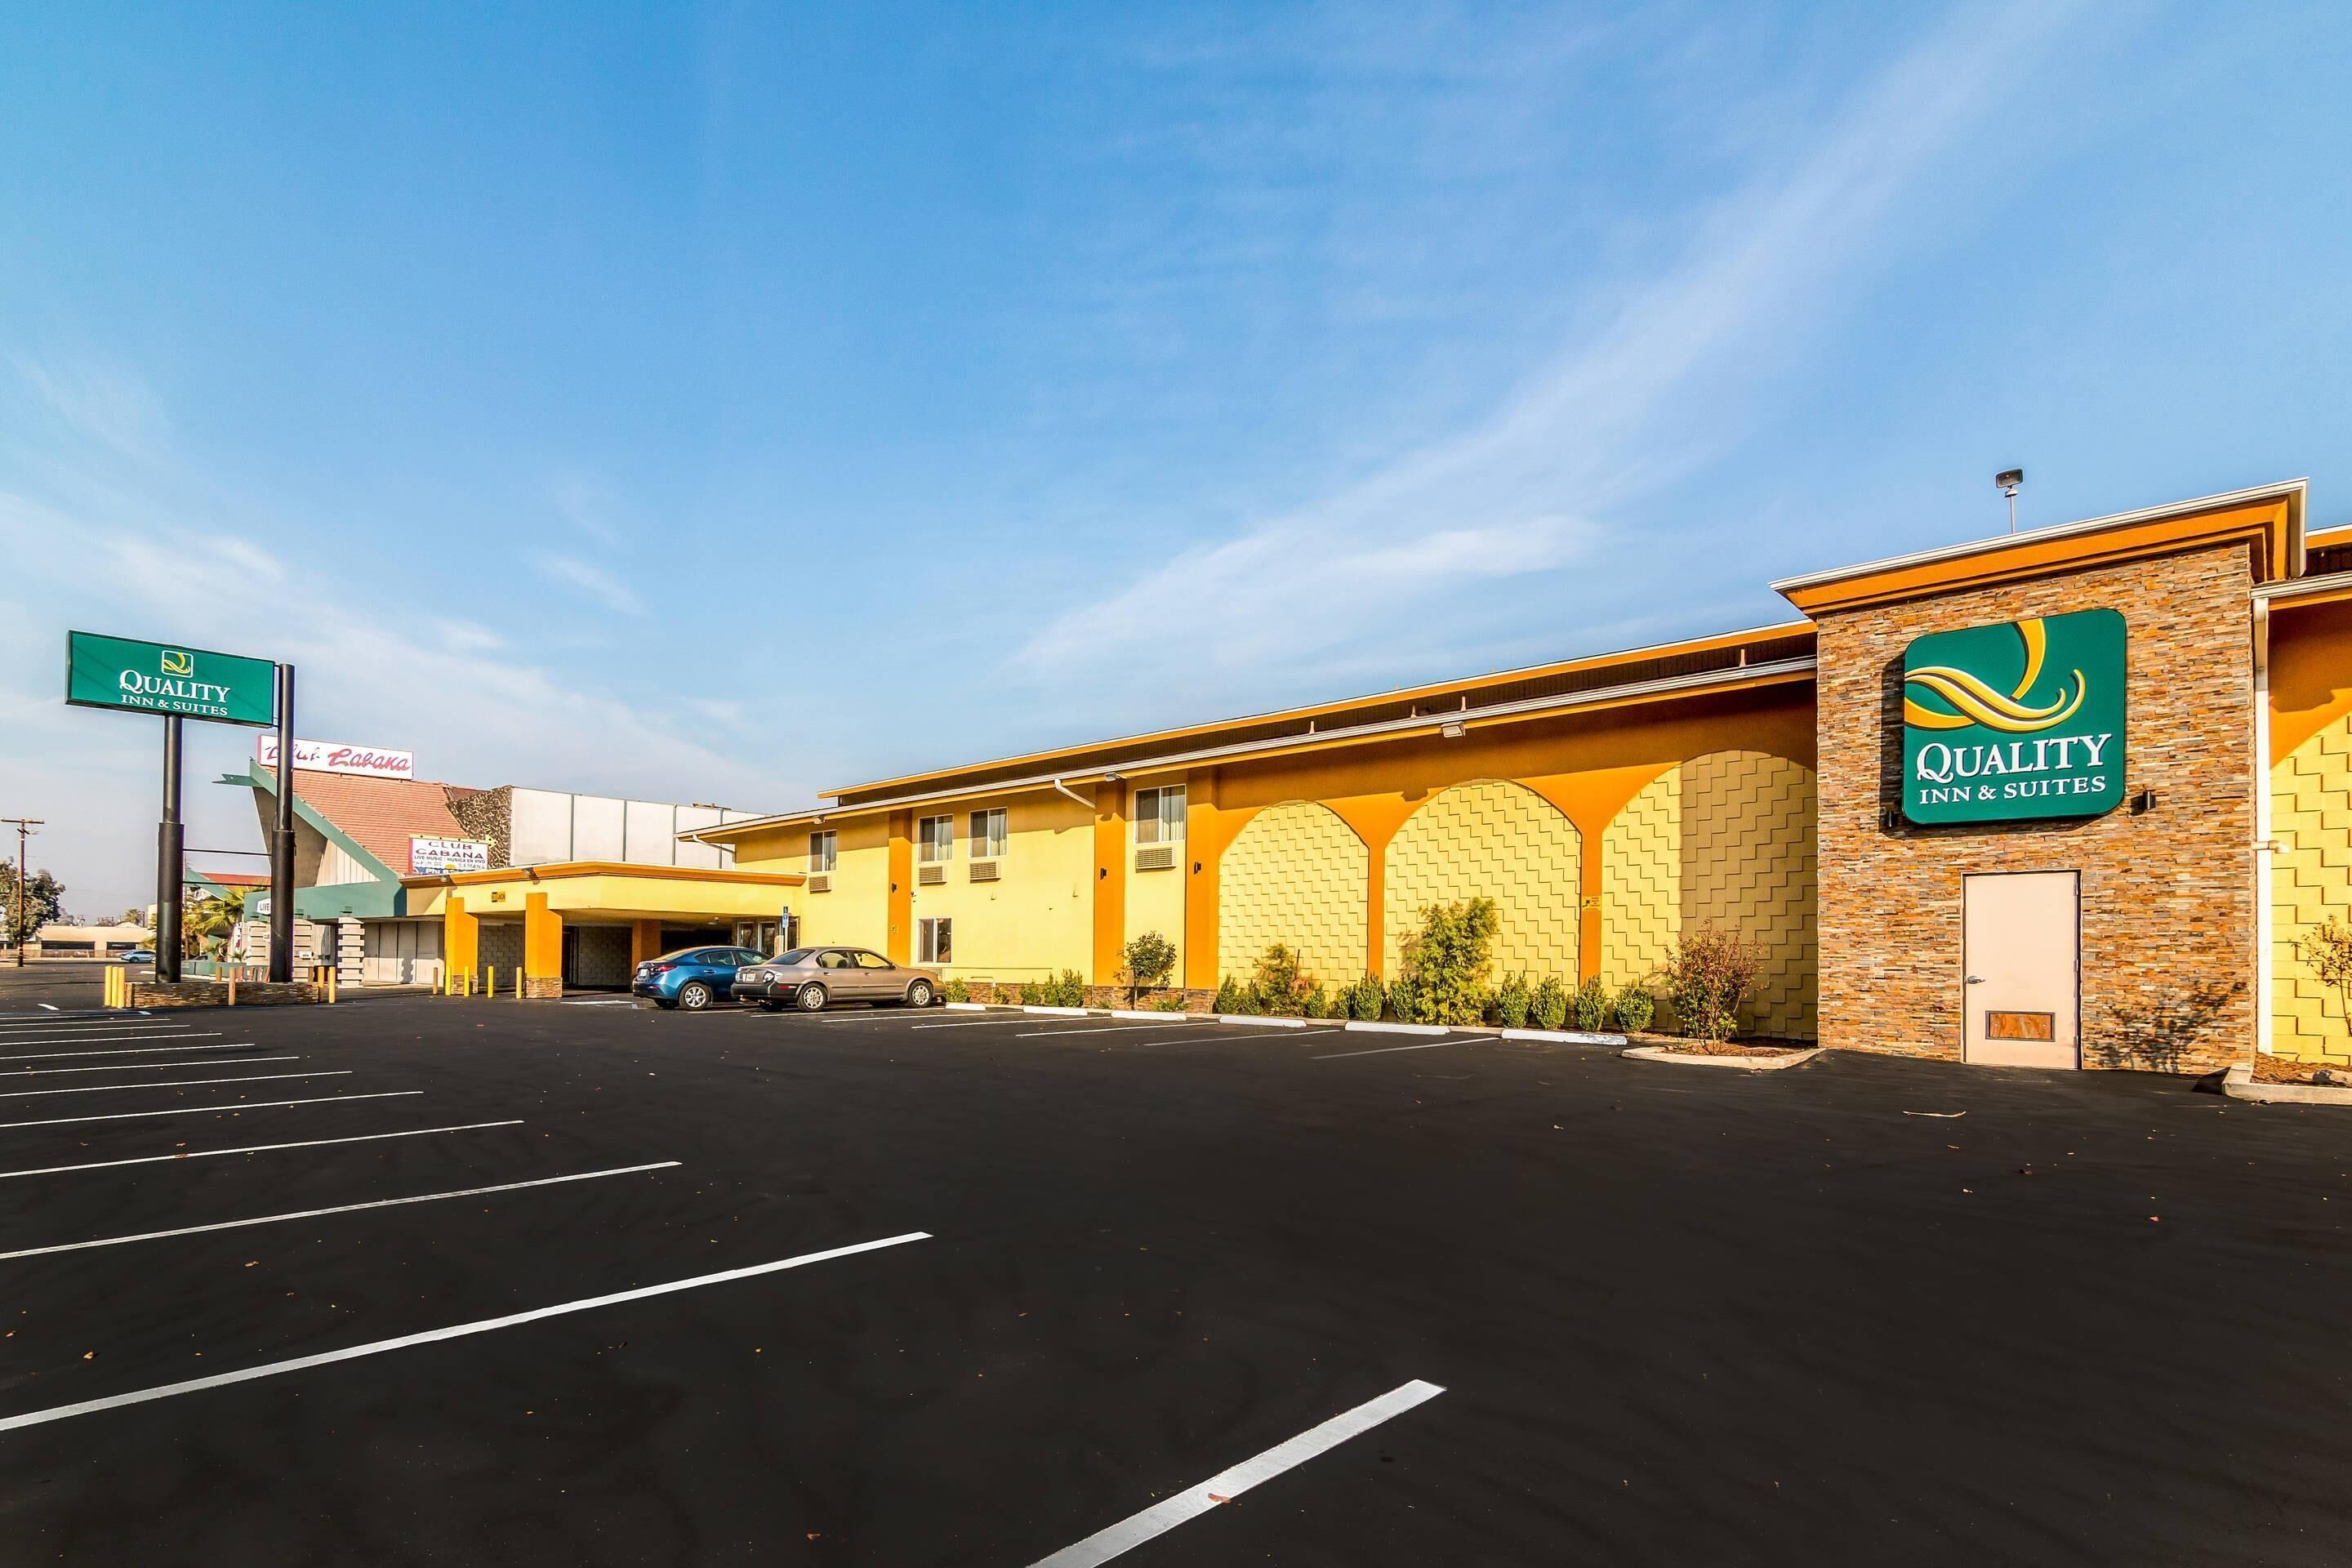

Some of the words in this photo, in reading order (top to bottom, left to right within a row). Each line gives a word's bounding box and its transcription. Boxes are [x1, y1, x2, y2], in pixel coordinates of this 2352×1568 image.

[119, 670, 231, 703] QUALITY
[121, 694, 154, 706] INN
[158, 699, 170, 709] &
[172, 701, 228, 716] SUITES
[1917, 733, 2112, 784] QUALITY
[1920, 786, 1972, 804] INN
[1978, 785, 1997, 800] &
[2004, 776, 2106, 799] SUITES
[415, 849, 483, 859] CABANA
[428, 841, 472, 849] CLUB
[260, 902, 270, 911] LIVE
